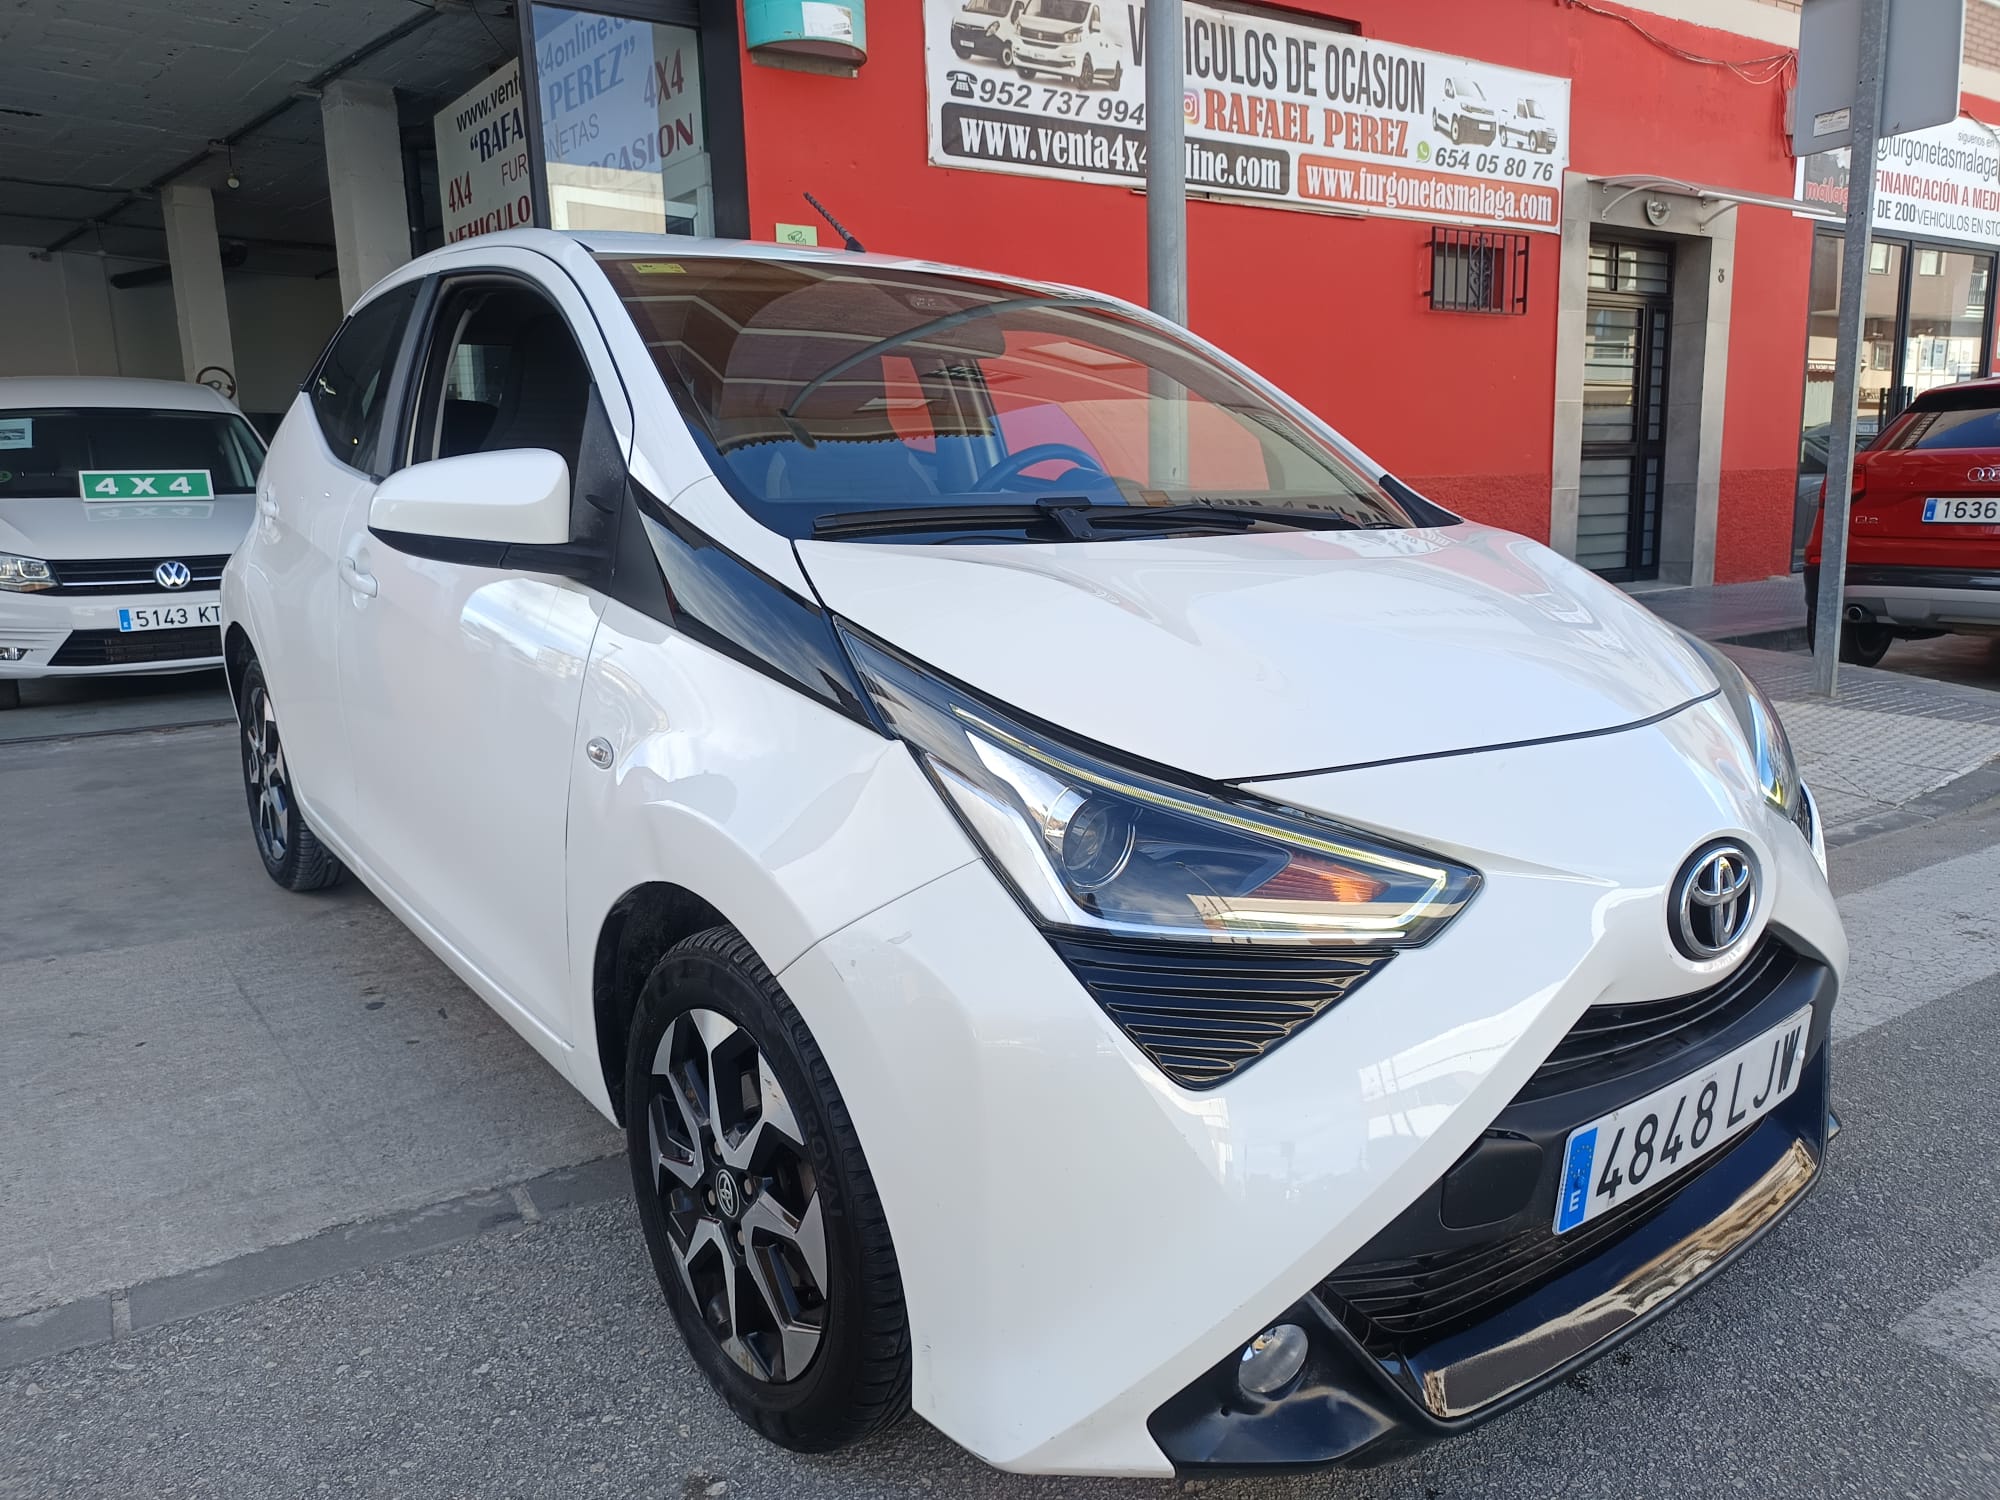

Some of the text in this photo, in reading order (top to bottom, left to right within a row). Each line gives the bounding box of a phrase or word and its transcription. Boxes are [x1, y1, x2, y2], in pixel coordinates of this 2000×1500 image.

[1127, 4, 1425, 115] VICULOS DE OCASION
[978, 79, 1145, 125] 952 737 994
[1204, 88, 1408, 158] RAFAEL PEREZ
[448, 170, 473, 213] 4X4
[643, 48, 685, 109] 4X4
[1435, 147, 1555, 182] 654 05 80 76
[1305, 165, 1553, 223] www.furgonetasmalaga.com
[1877, 199, 1893, 220] DE
[1894, 201, 1917, 223] 200
[1917, 208, 1970, 232] VEHICULOS
[1971, 217, 1984, 234] EN
[1961, 186, 1970, 208] A
[1944, 501, 1999, 519] 1636
[135, 605, 220, 628] 5143 KT
[1569, 1025, 1802, 1213] E 4848 LJW
